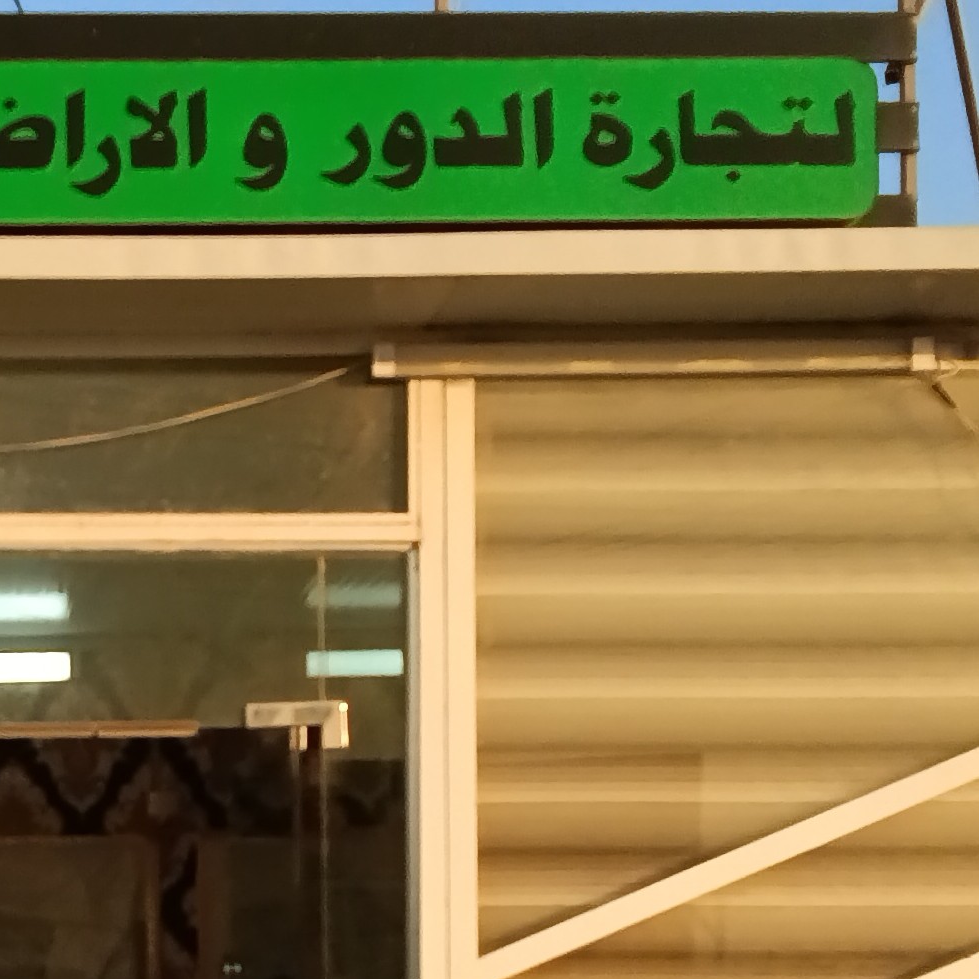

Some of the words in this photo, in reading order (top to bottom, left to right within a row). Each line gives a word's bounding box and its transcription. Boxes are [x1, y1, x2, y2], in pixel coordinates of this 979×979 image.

[237, 111, 289, 192] و
[320, 89, 556, 191] الدور
[582, 91, 856, 192] لتجارة
